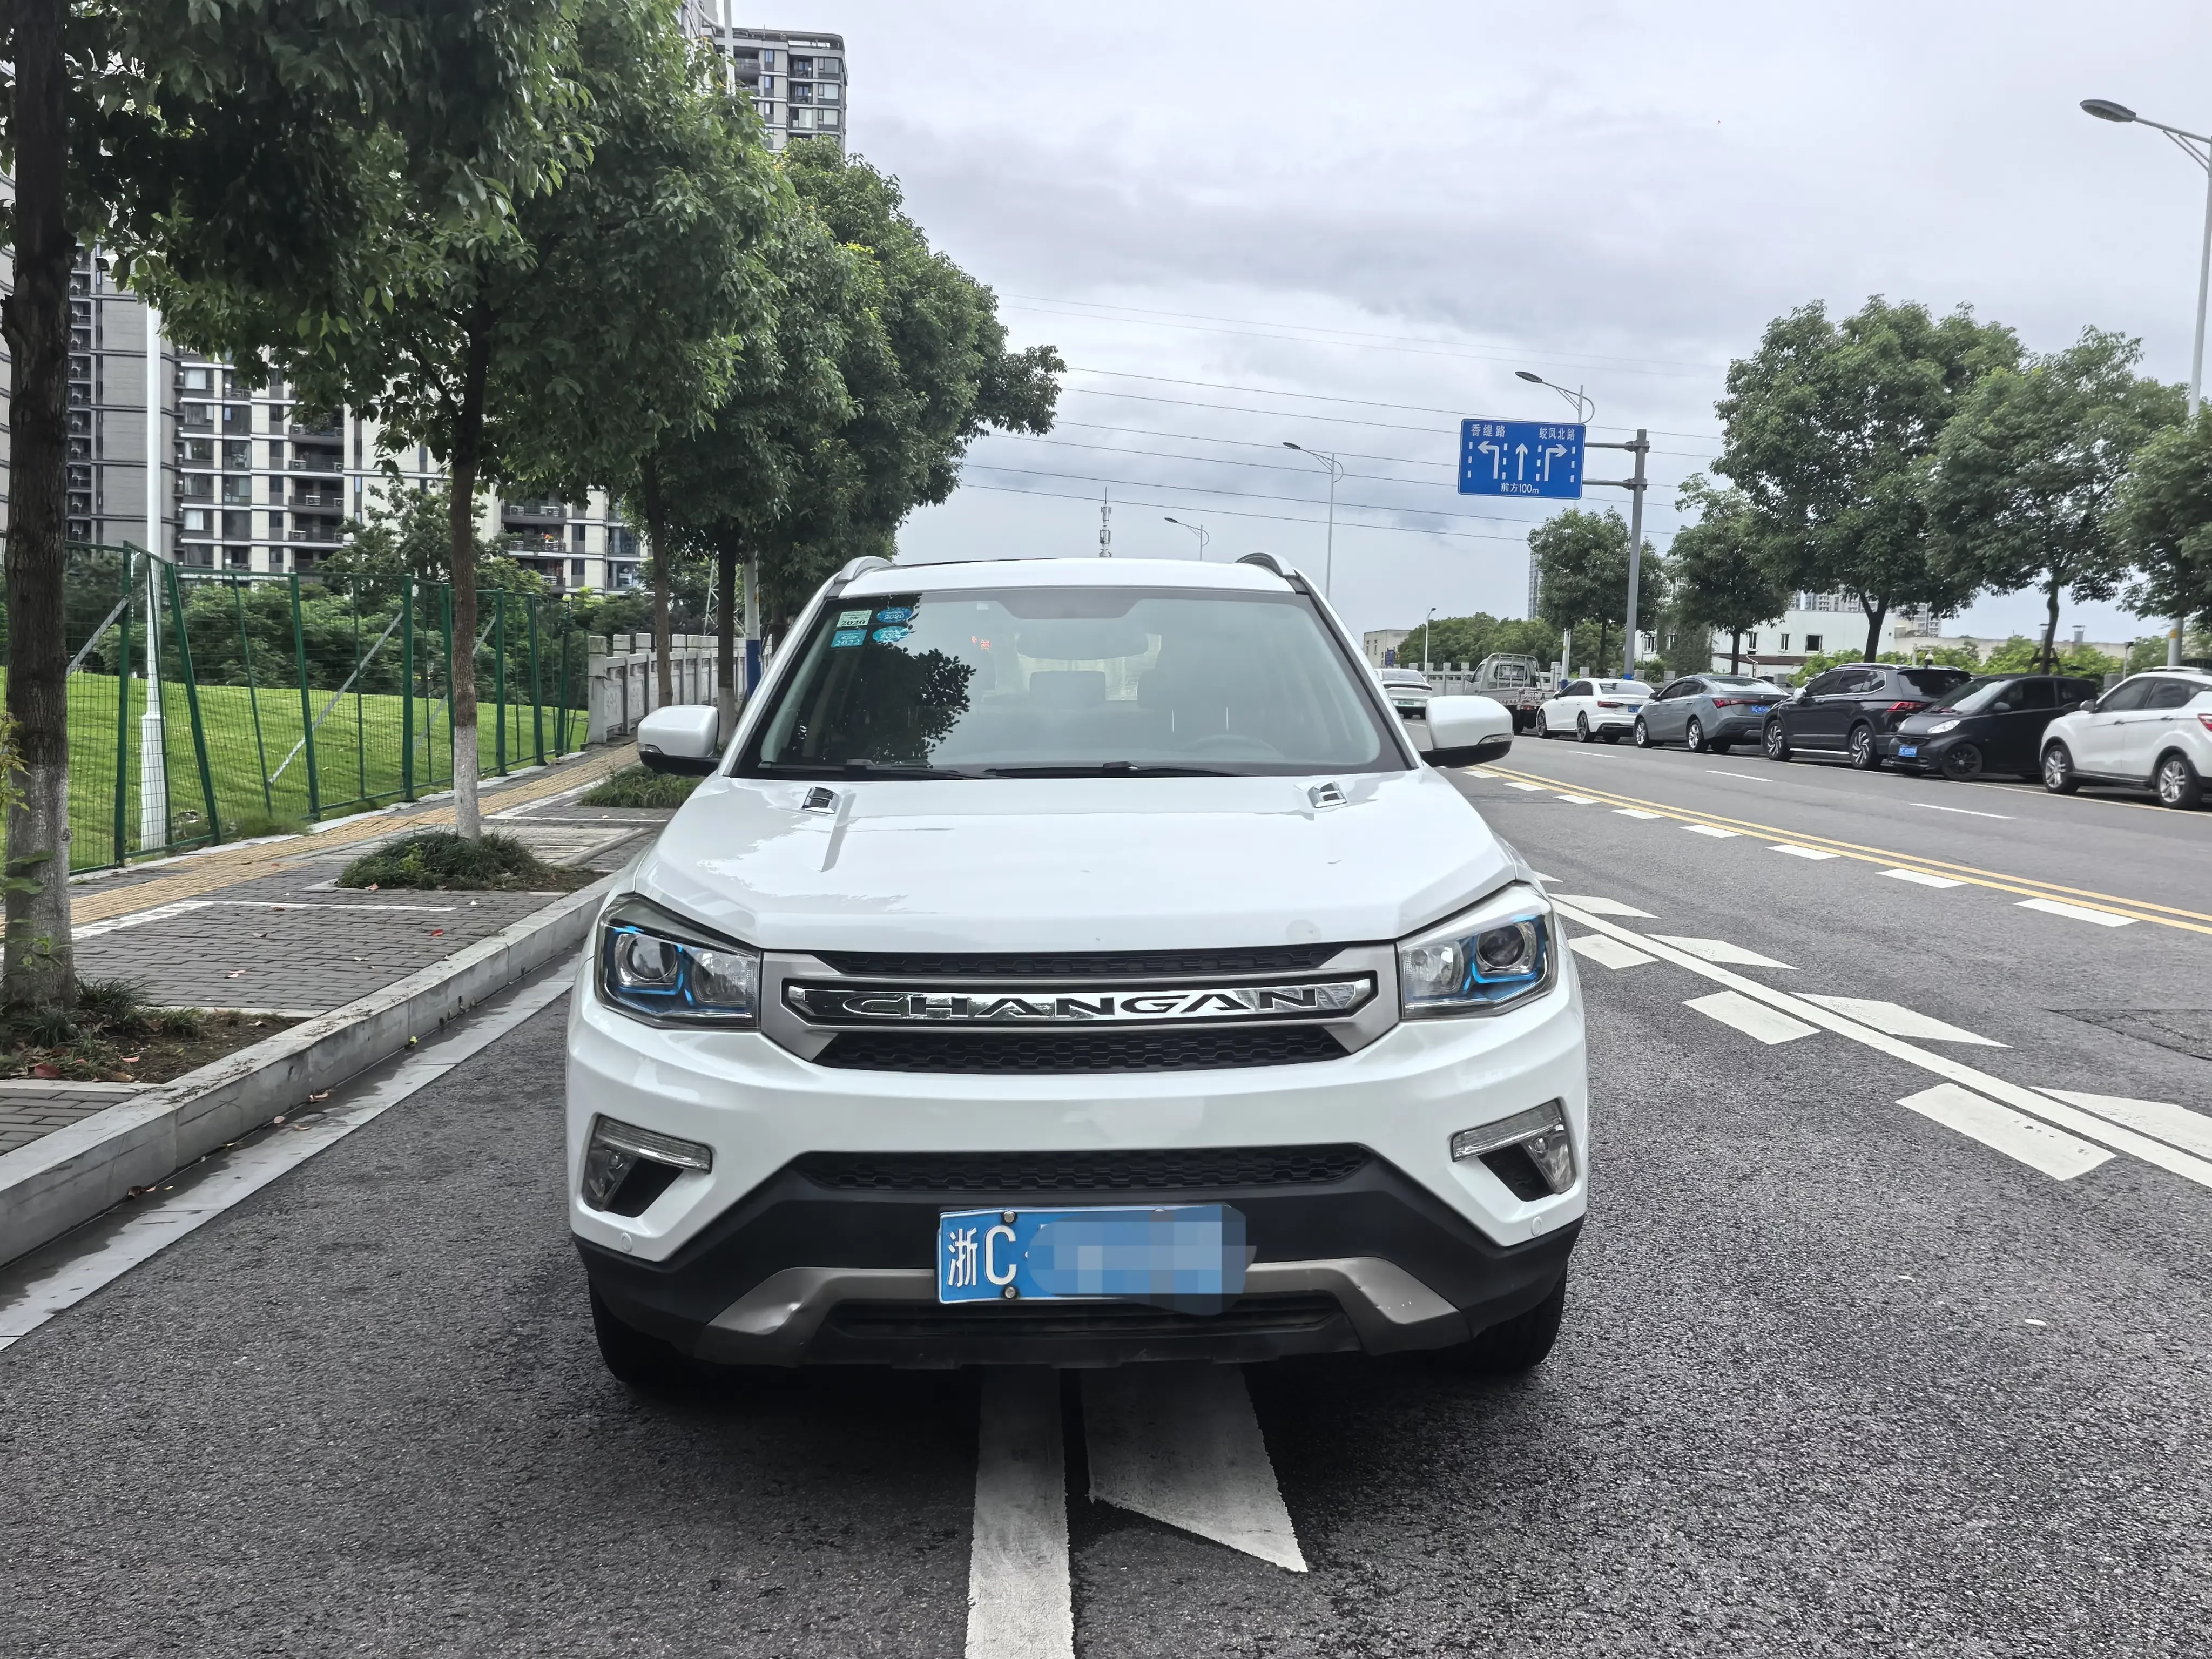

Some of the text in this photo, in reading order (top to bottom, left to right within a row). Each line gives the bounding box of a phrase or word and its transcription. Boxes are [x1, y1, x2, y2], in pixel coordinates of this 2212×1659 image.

[1471, 424, 1506, 437] 香缇路
[1501, 482, 1539, 494] 前方100m
[843, 988, 1317, 1017] CHANGAN
